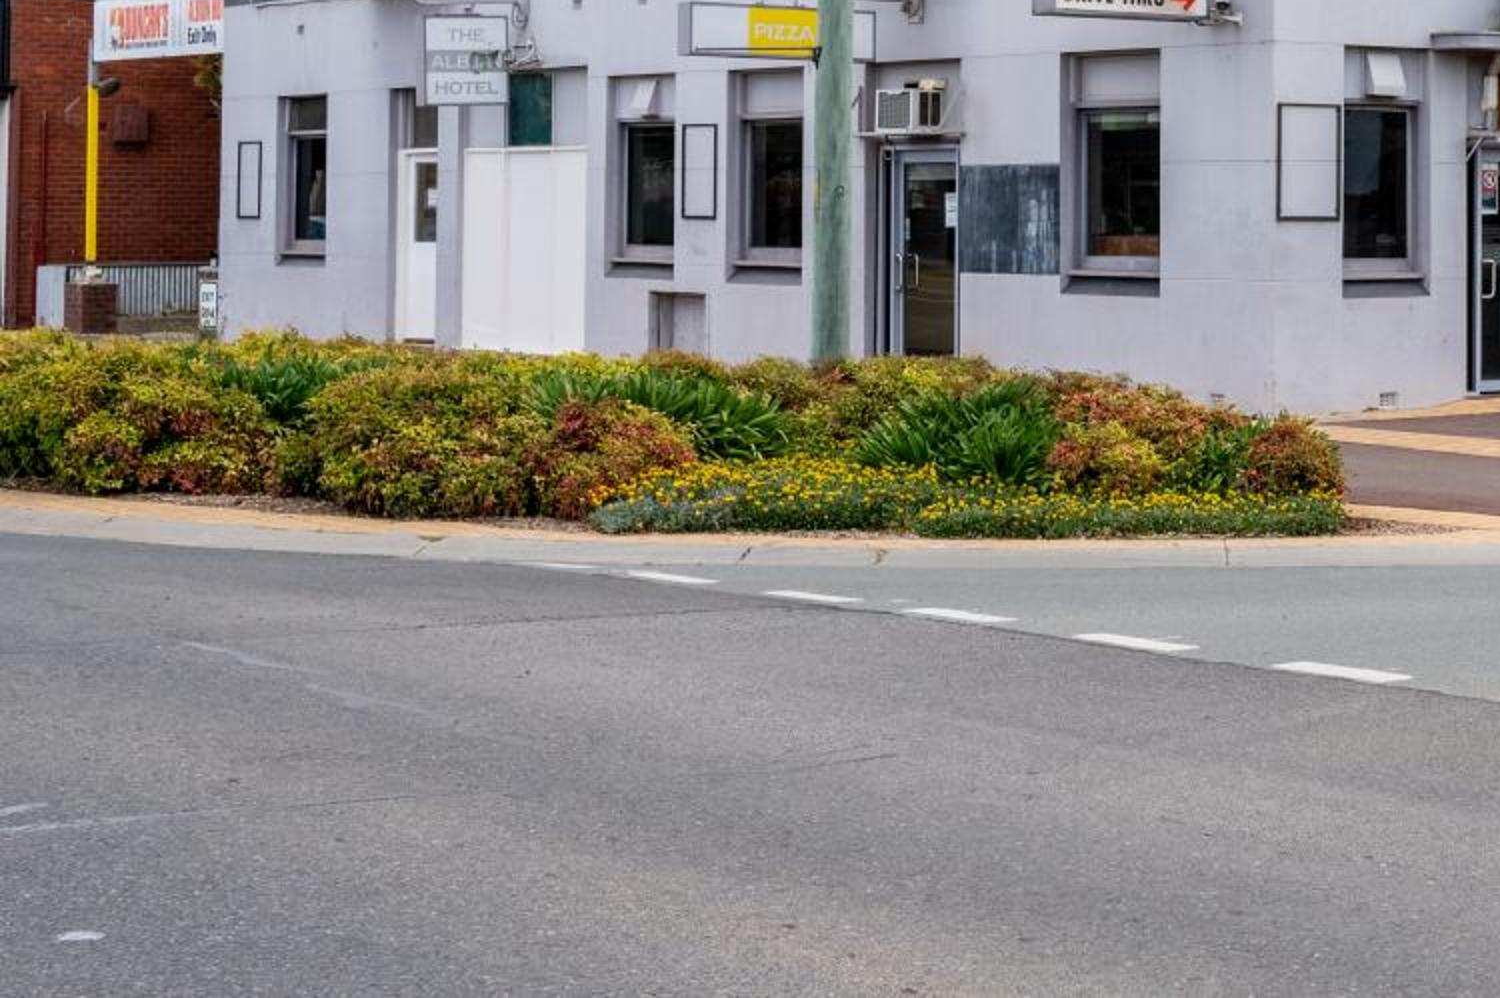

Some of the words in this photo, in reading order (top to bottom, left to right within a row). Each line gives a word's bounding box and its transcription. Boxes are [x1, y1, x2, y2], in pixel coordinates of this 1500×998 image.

[449, 27, 484, 41] THE
[754, 23, 817, 44] PIZZA
[434, 81, 499, 95] HOTEL
